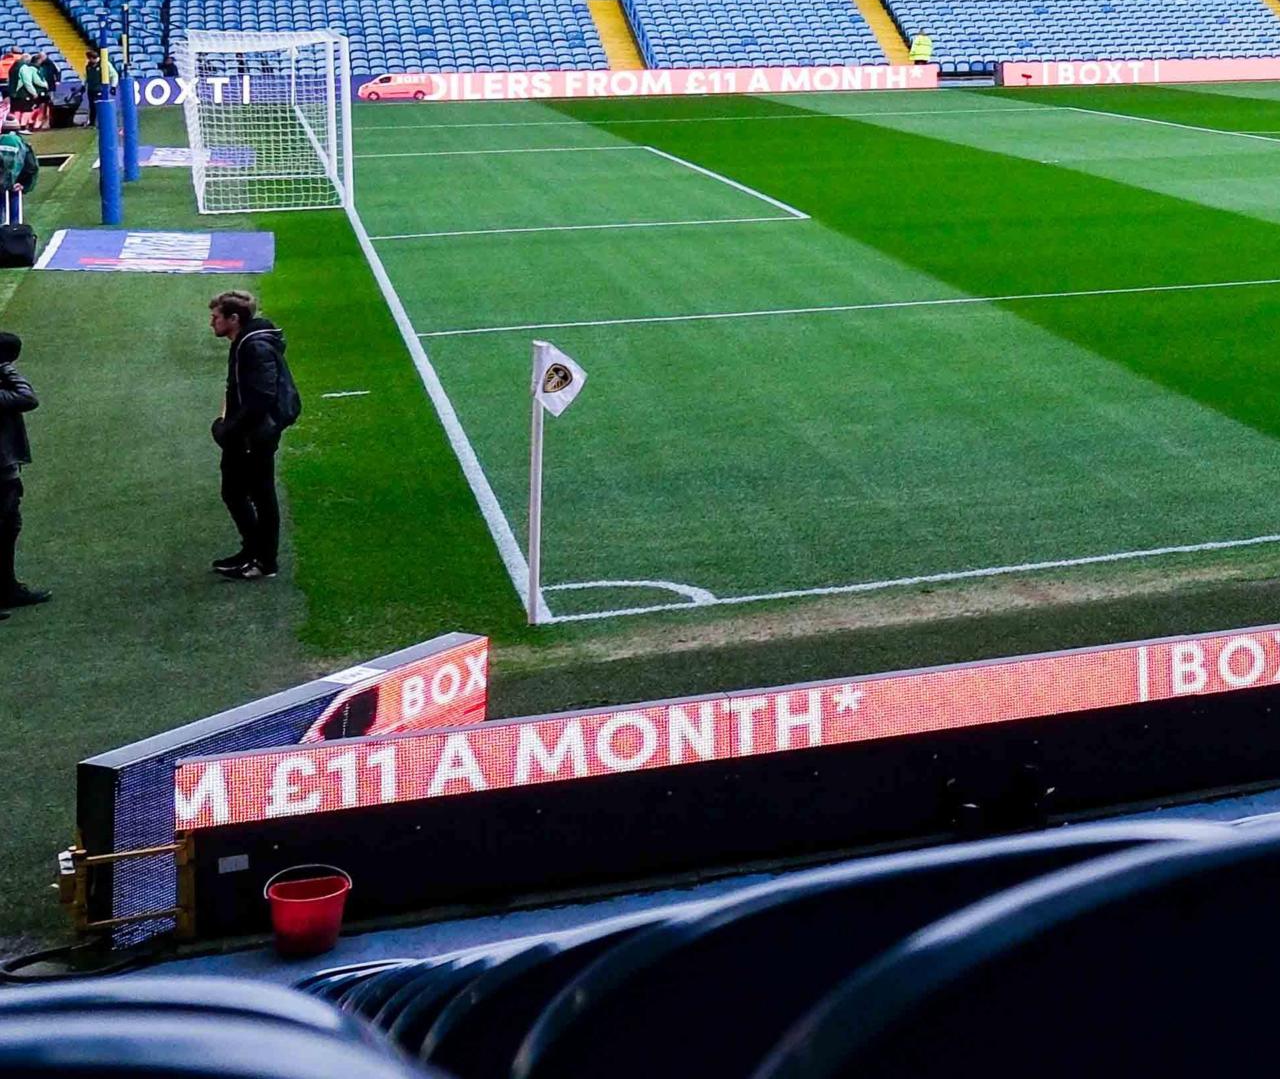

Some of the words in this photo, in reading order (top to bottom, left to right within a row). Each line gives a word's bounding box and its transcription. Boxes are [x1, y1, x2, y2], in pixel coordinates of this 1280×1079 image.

[565, 70, 662, 96] FROM
[684, 68, 737, 94] £11
[744, 67, 767, 92] A
[265, 745, 397, 819] £11
[427, 731, 490, 797] A
